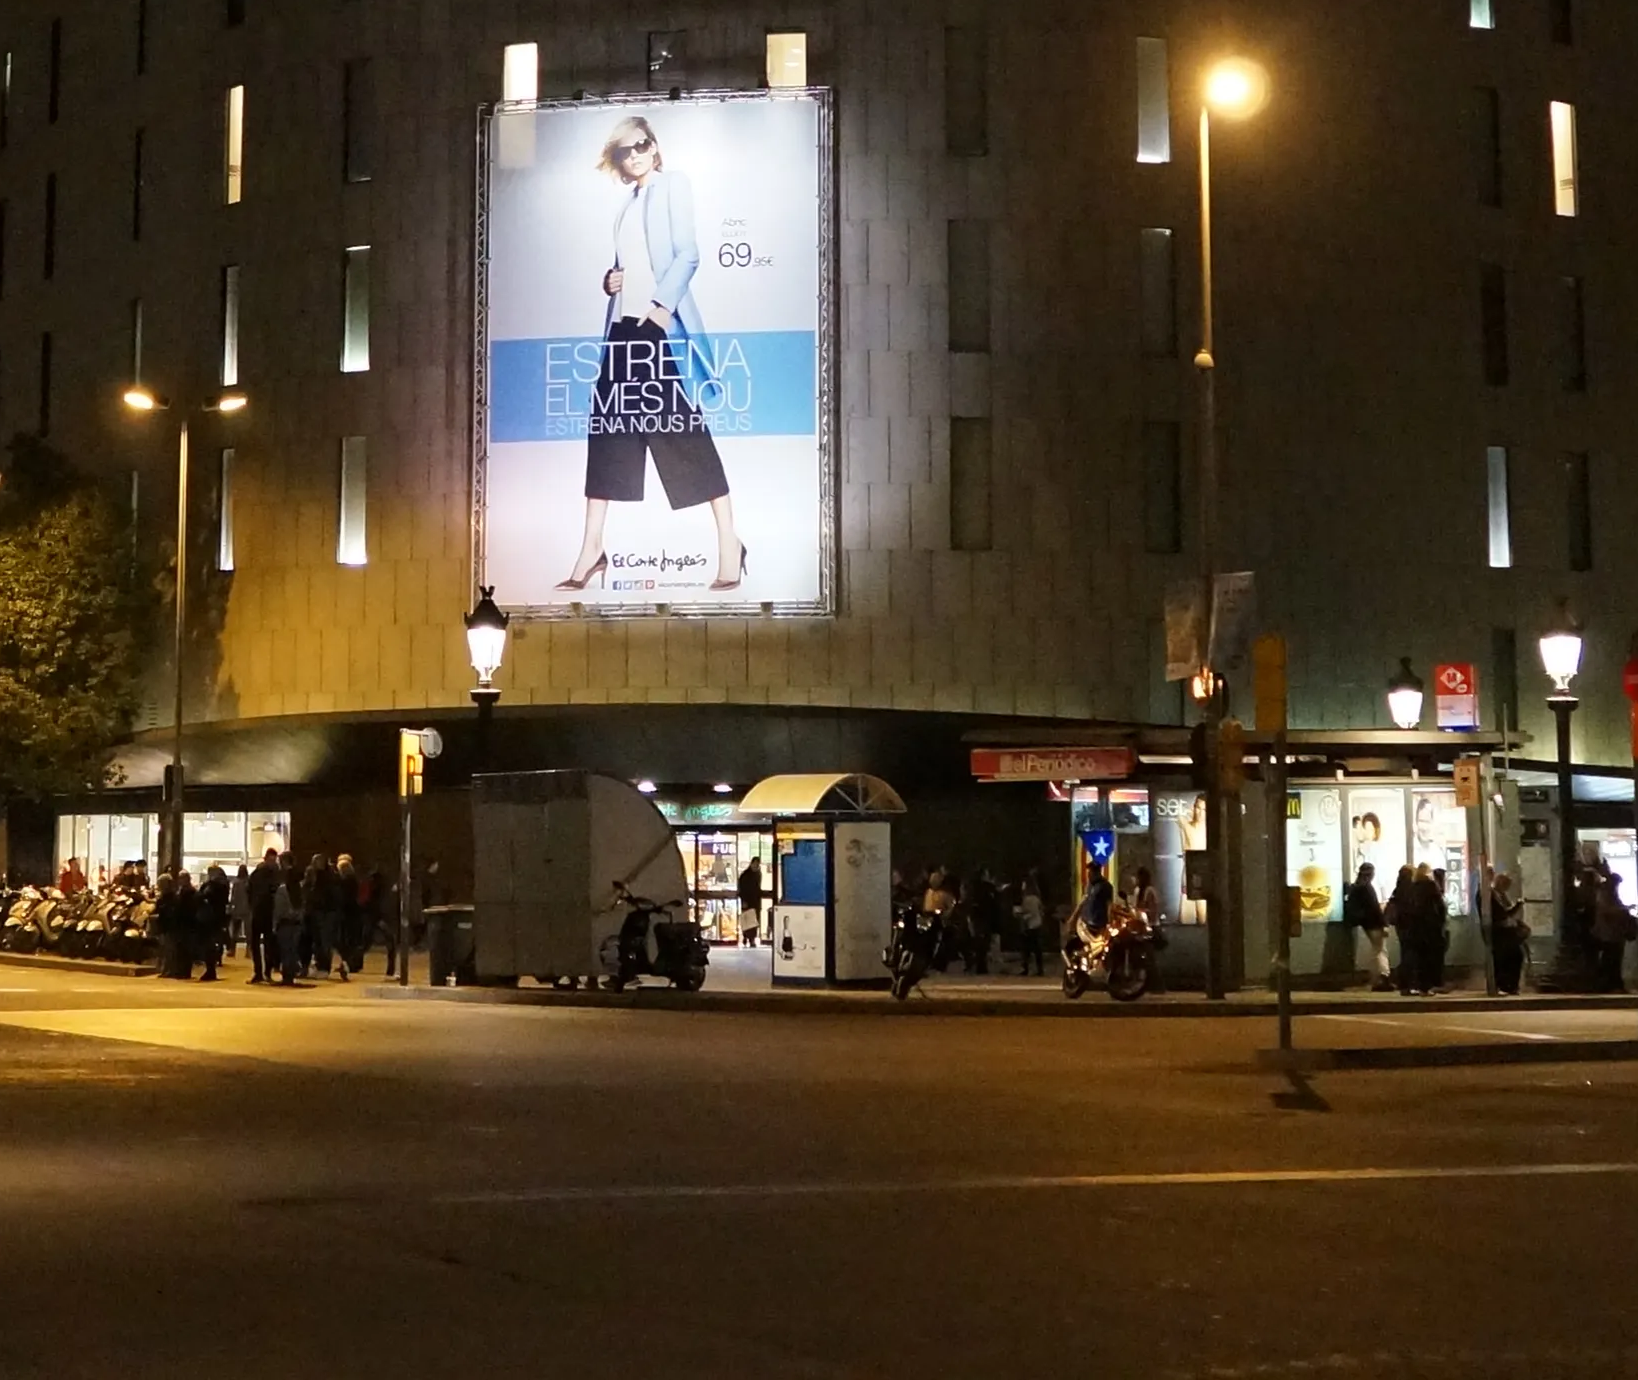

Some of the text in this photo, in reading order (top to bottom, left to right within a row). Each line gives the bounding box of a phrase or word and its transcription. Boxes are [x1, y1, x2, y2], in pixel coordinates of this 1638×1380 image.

[546, 338, 752, 384] ESTRENA
[546, 377, 752, 416] EL MÉS NOU
[545, 412, 753, 437] ESTRENA NOUS PREUS
[612, 548, 707, 572] El Corte Inglés
